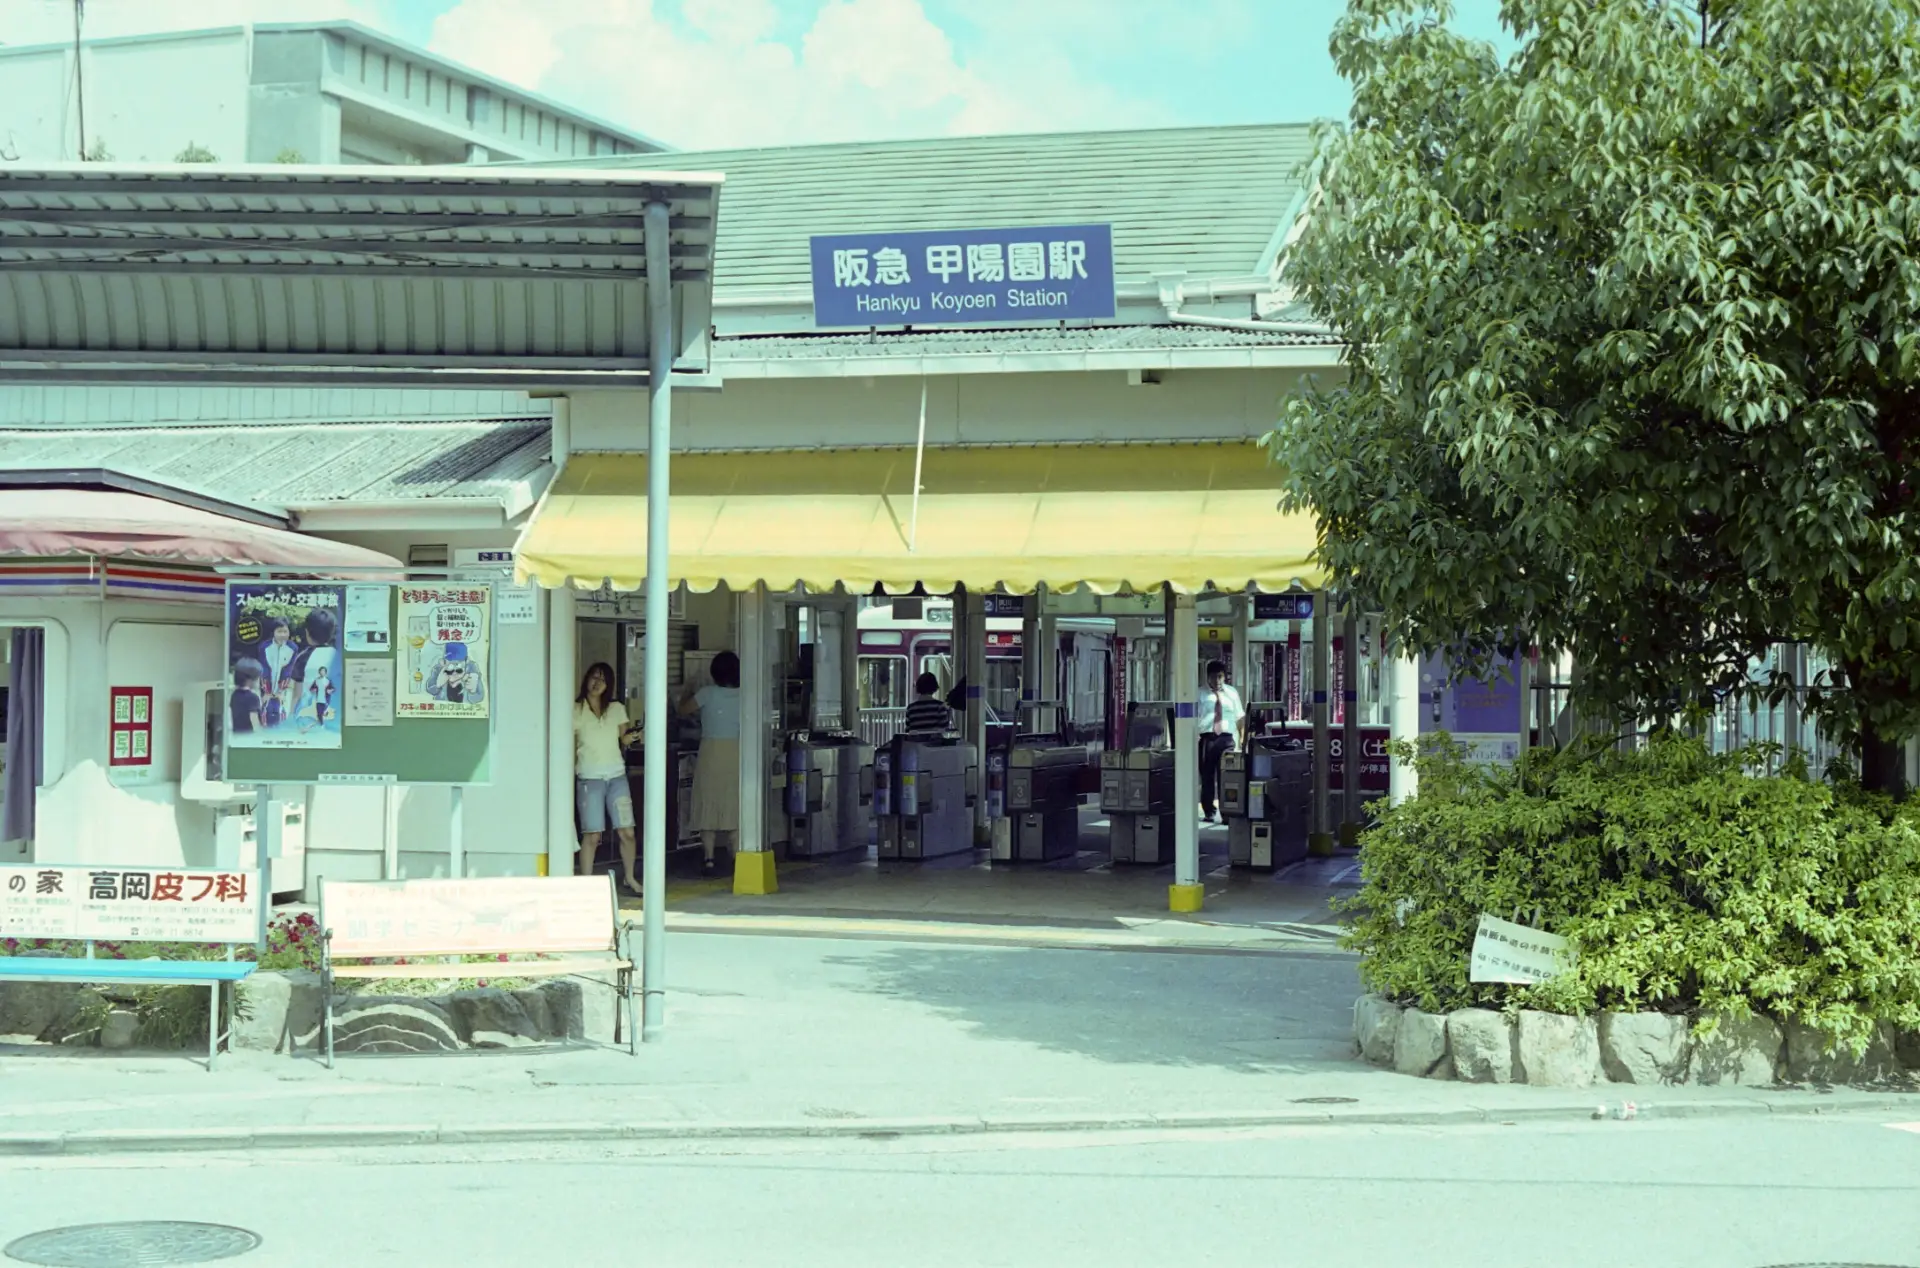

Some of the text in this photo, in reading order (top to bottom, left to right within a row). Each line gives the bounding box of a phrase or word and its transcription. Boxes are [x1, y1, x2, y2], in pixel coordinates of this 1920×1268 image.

[833, 240, 1088, 288] 阪急 甲陽園駅
[857, 289, 1068, 315] Hankyu Koyoen Station
[1017, 787, 1024, 797] 3
[1133, 789, 1141, 799] 4
[89, 871, 247, 902] 高岡皮フ科
